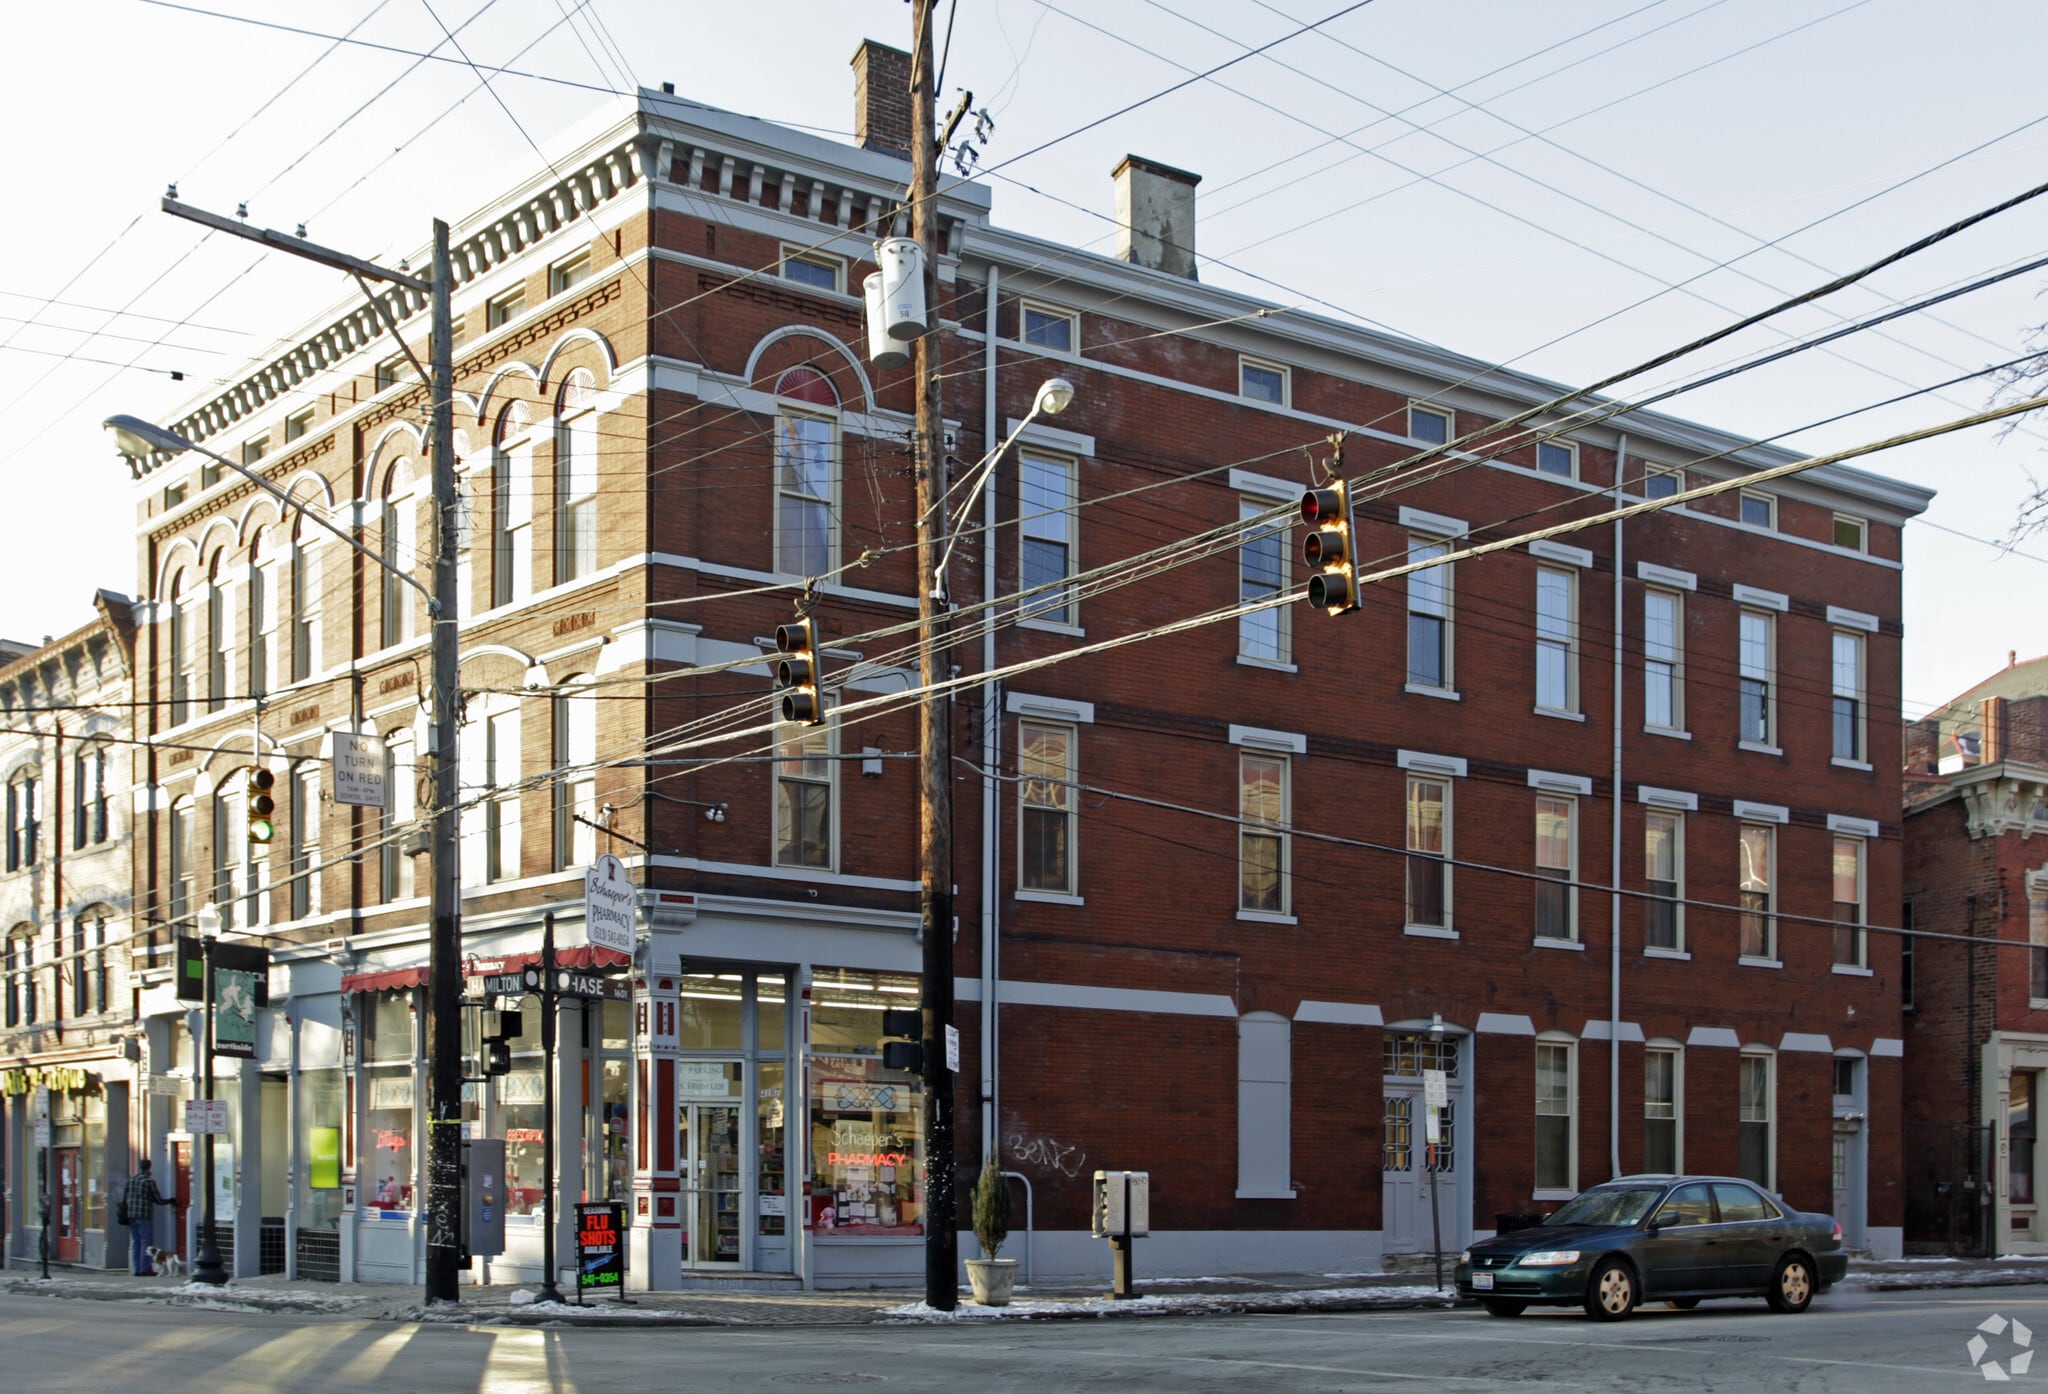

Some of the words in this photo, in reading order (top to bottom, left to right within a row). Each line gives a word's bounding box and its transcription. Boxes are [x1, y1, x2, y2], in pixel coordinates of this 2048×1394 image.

[350, 741, 368, 753] NO
[344, 755, 375, 768] TURN
[338, 771, 354, 782] ON
[360, 773, 381, 785] RED
[592, 904, 631, 932] PHARMACY
[471, 976, 520, 993] HAMILTON
[572, 976, 604, 995] HASE
[688, 1066, 722, 1074] PARKING
[830, 1124, 904, 1151] Schaeper's
[827, 1152, 907, 1167] PHARMACY
[586, 1214, 609, 1230] FLU
[579, 1230, 617, 1247] SHOTS
